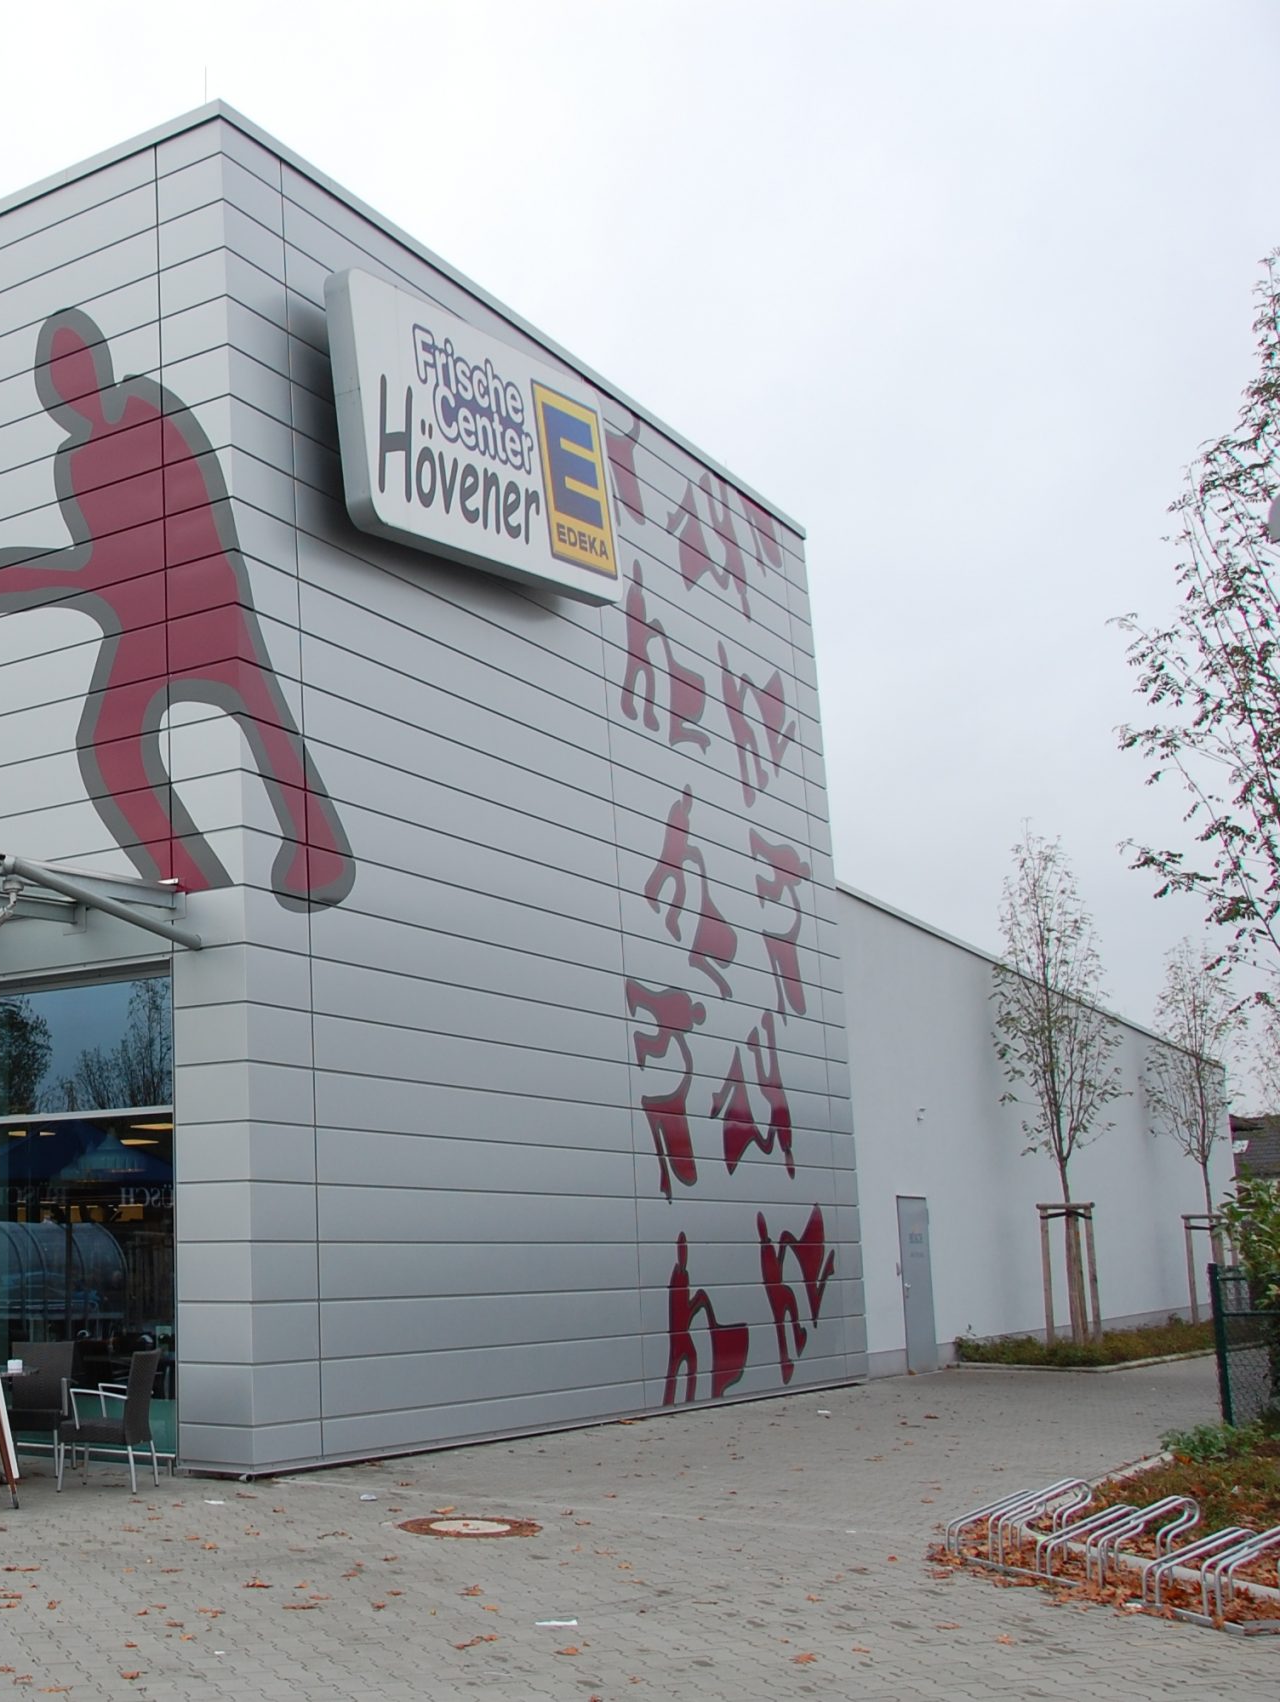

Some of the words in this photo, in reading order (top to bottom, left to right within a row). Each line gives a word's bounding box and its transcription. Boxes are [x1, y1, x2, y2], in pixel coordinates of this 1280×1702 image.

[412, 323, 523, 423] Frische
[378, 374, 540, 545] Hövener
[432, 386, 533, 475] Center
[541, 401, 604, 529] E
[556, 522, 609, 560] EDEKA
